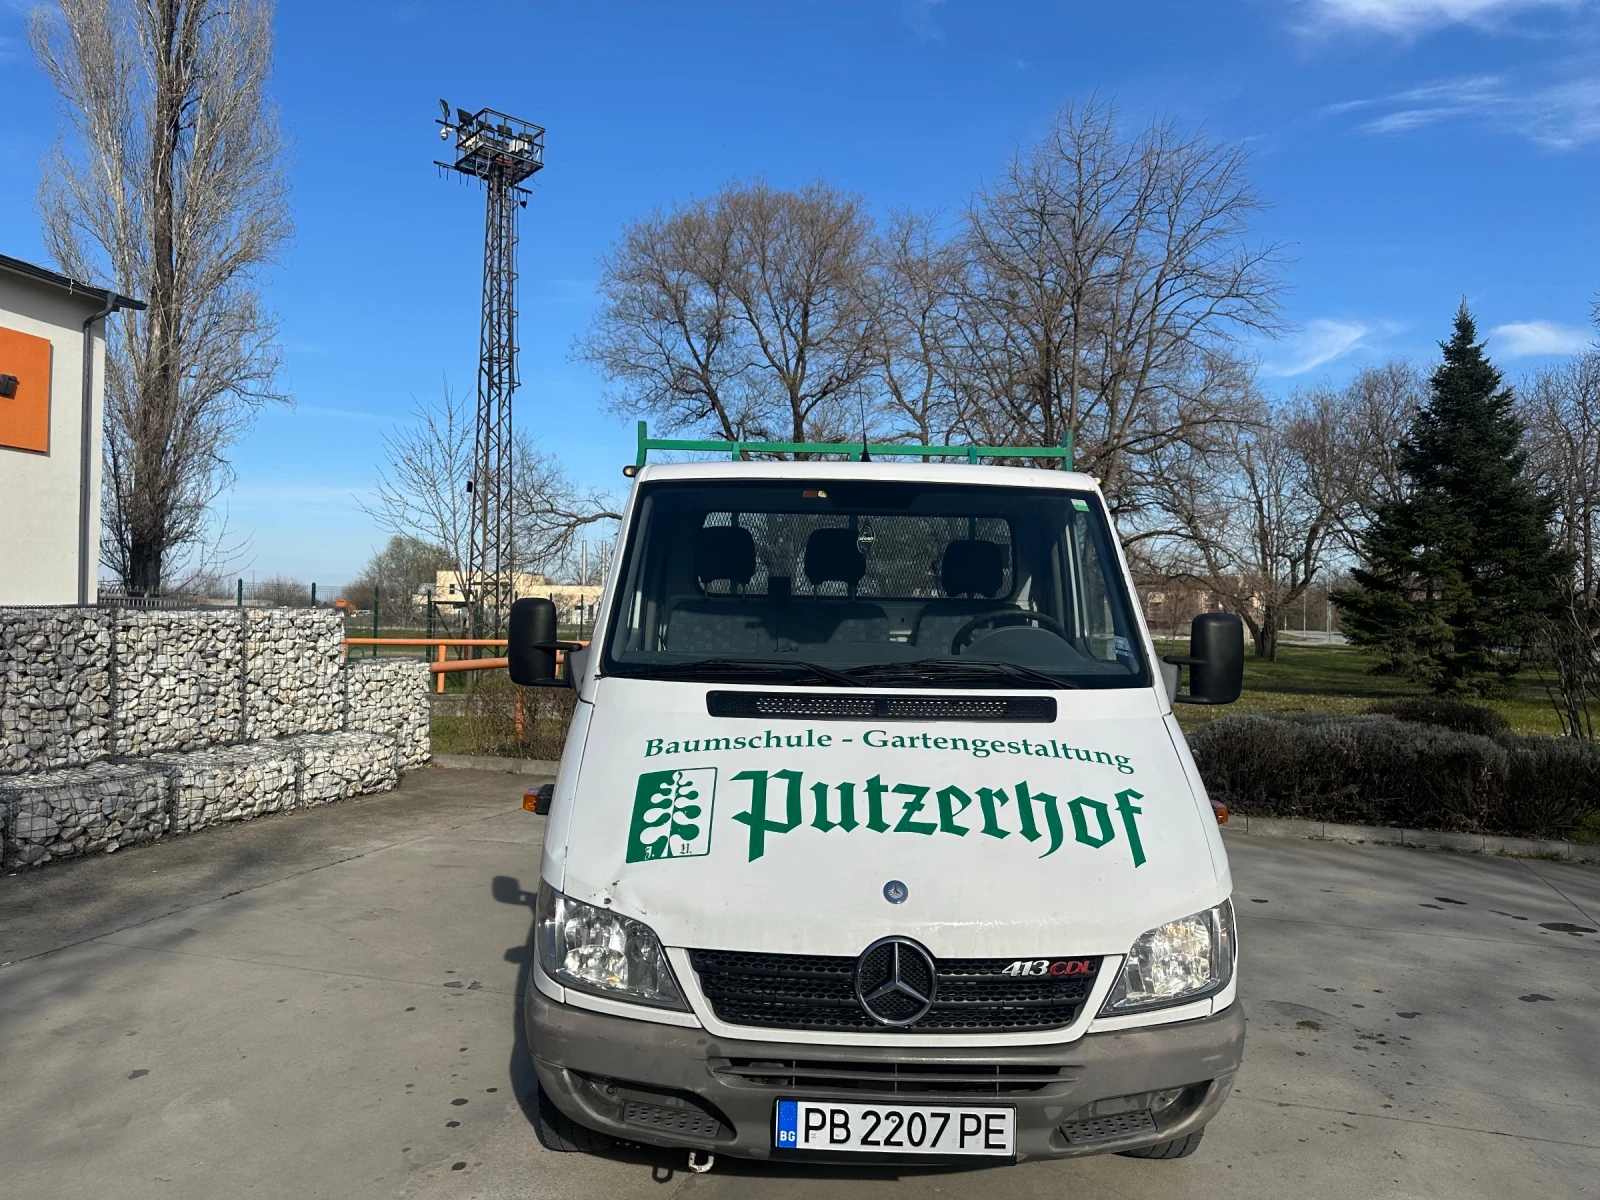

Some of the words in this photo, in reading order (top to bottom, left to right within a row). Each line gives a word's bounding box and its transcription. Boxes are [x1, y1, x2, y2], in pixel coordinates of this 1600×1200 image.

[644, 729, 832, 757] Baumschule
[863, 729, 1136, 775] Gartengestaltung
[730, 768, 1147, 868] Putzerhof
[779, 1130, 796, 1142] BG
[804, 1107, 851, 1145] PB
[860, 1109, 951, 1148] 2207
[959, 1113, 1007, 1150] PE
